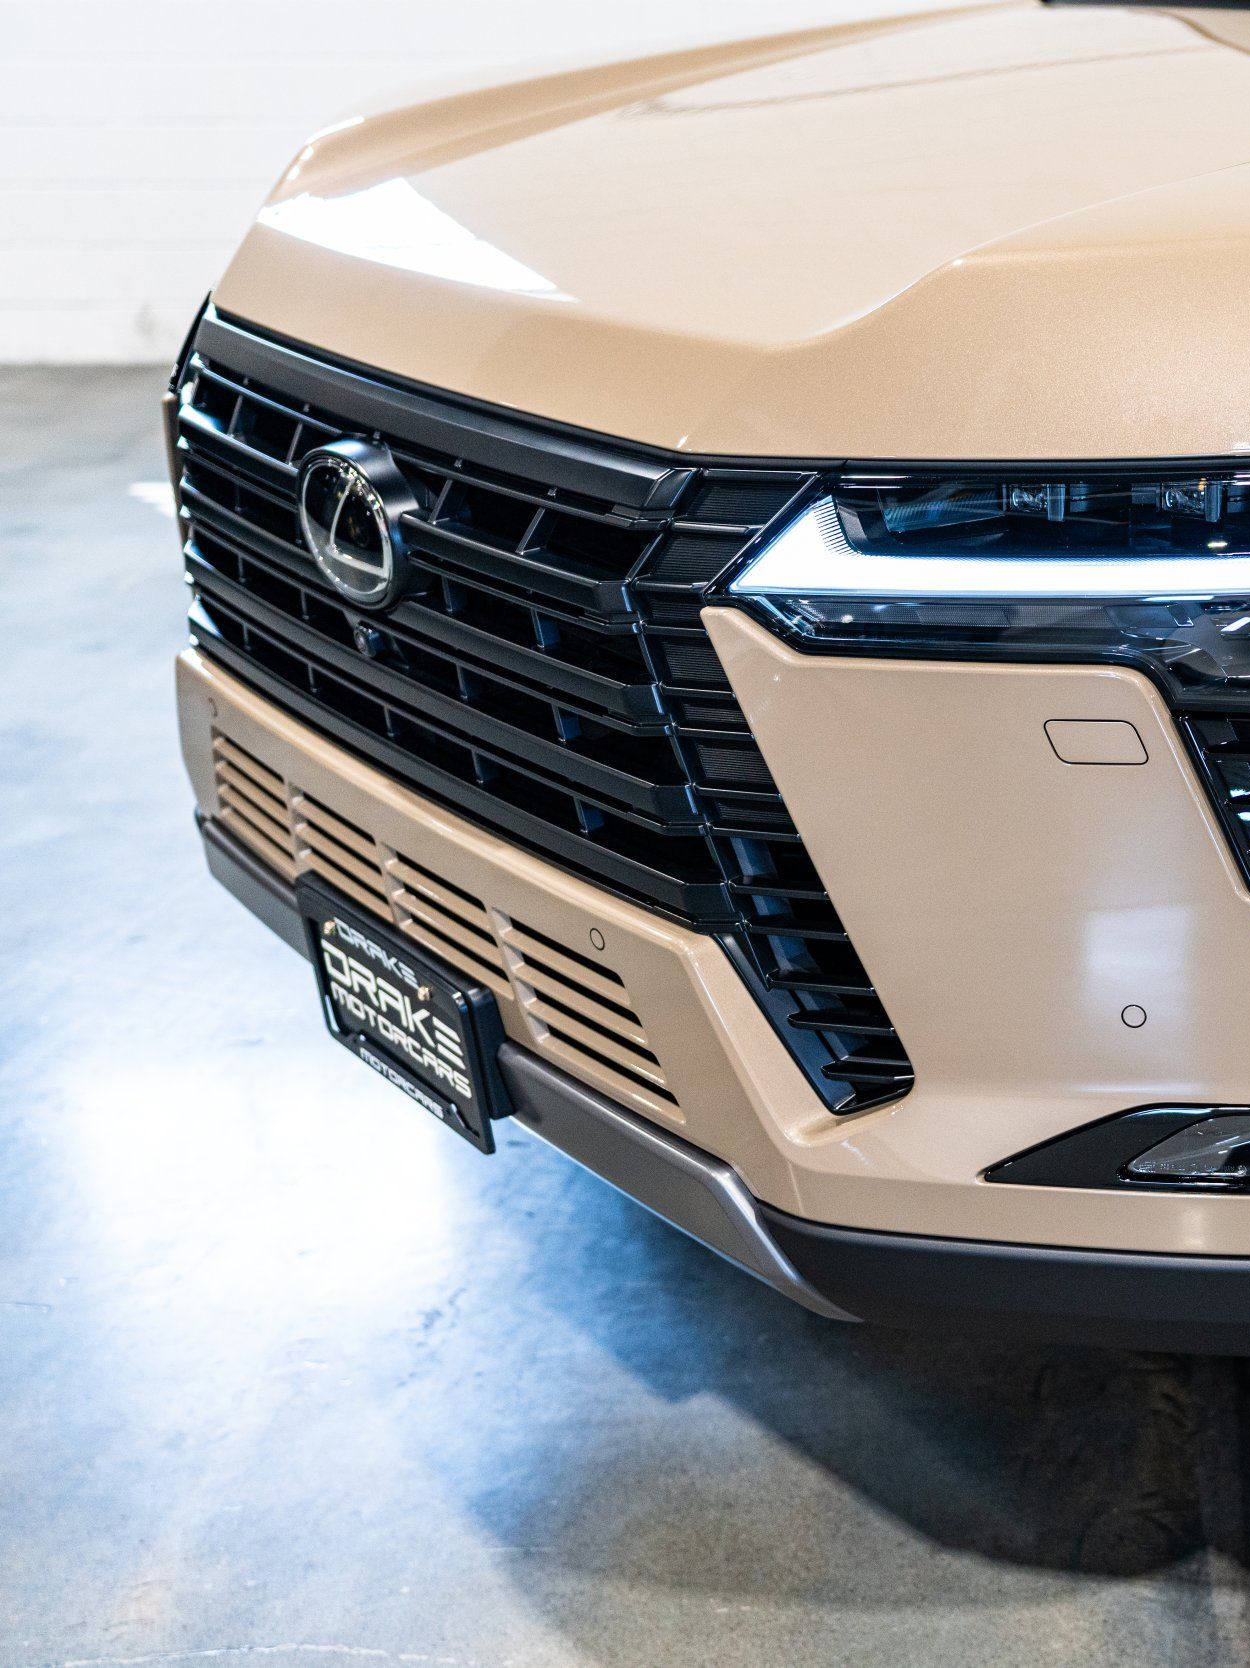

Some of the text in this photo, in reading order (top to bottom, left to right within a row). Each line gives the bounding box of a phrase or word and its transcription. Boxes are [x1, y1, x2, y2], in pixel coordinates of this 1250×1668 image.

[334, 917, 420, 989] DRAKE
[321, 939, 467, 1070] DRAKE
[330, 982, 472, 1099] MOTORCARS
[359, 1047, 444, 1119] MOTORCARS
